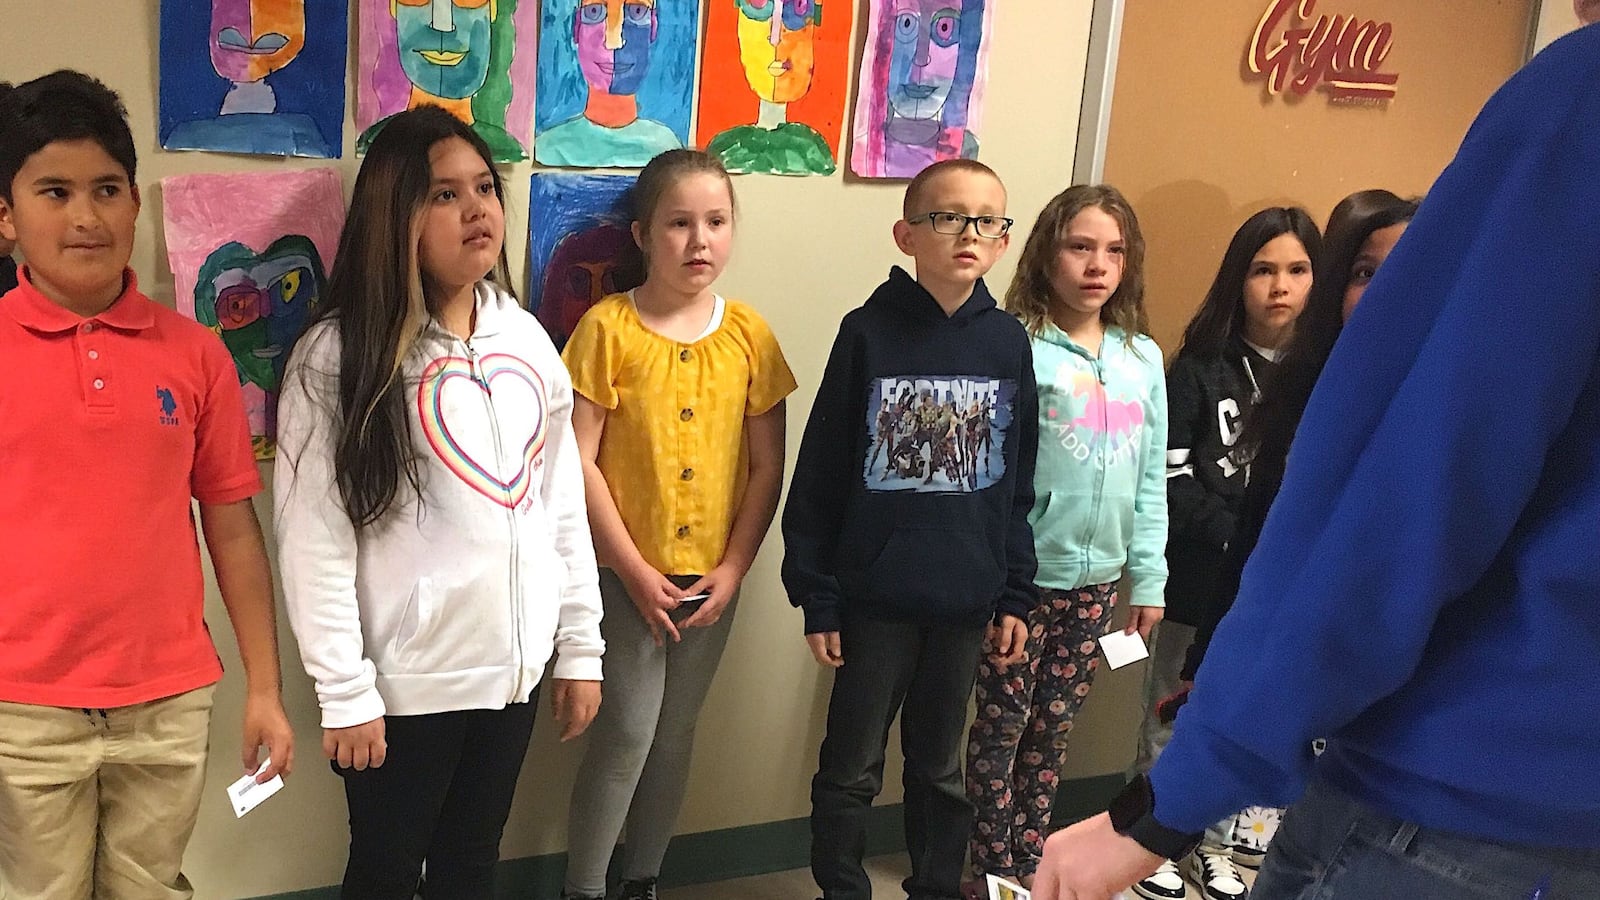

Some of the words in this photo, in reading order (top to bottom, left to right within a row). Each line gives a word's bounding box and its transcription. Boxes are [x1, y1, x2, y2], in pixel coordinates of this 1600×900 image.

[1248, 0, 1393, 96] Gym
[880, 377, 1000, 420] FORTNITE
[1052, 423, 1091, 461] ADD
